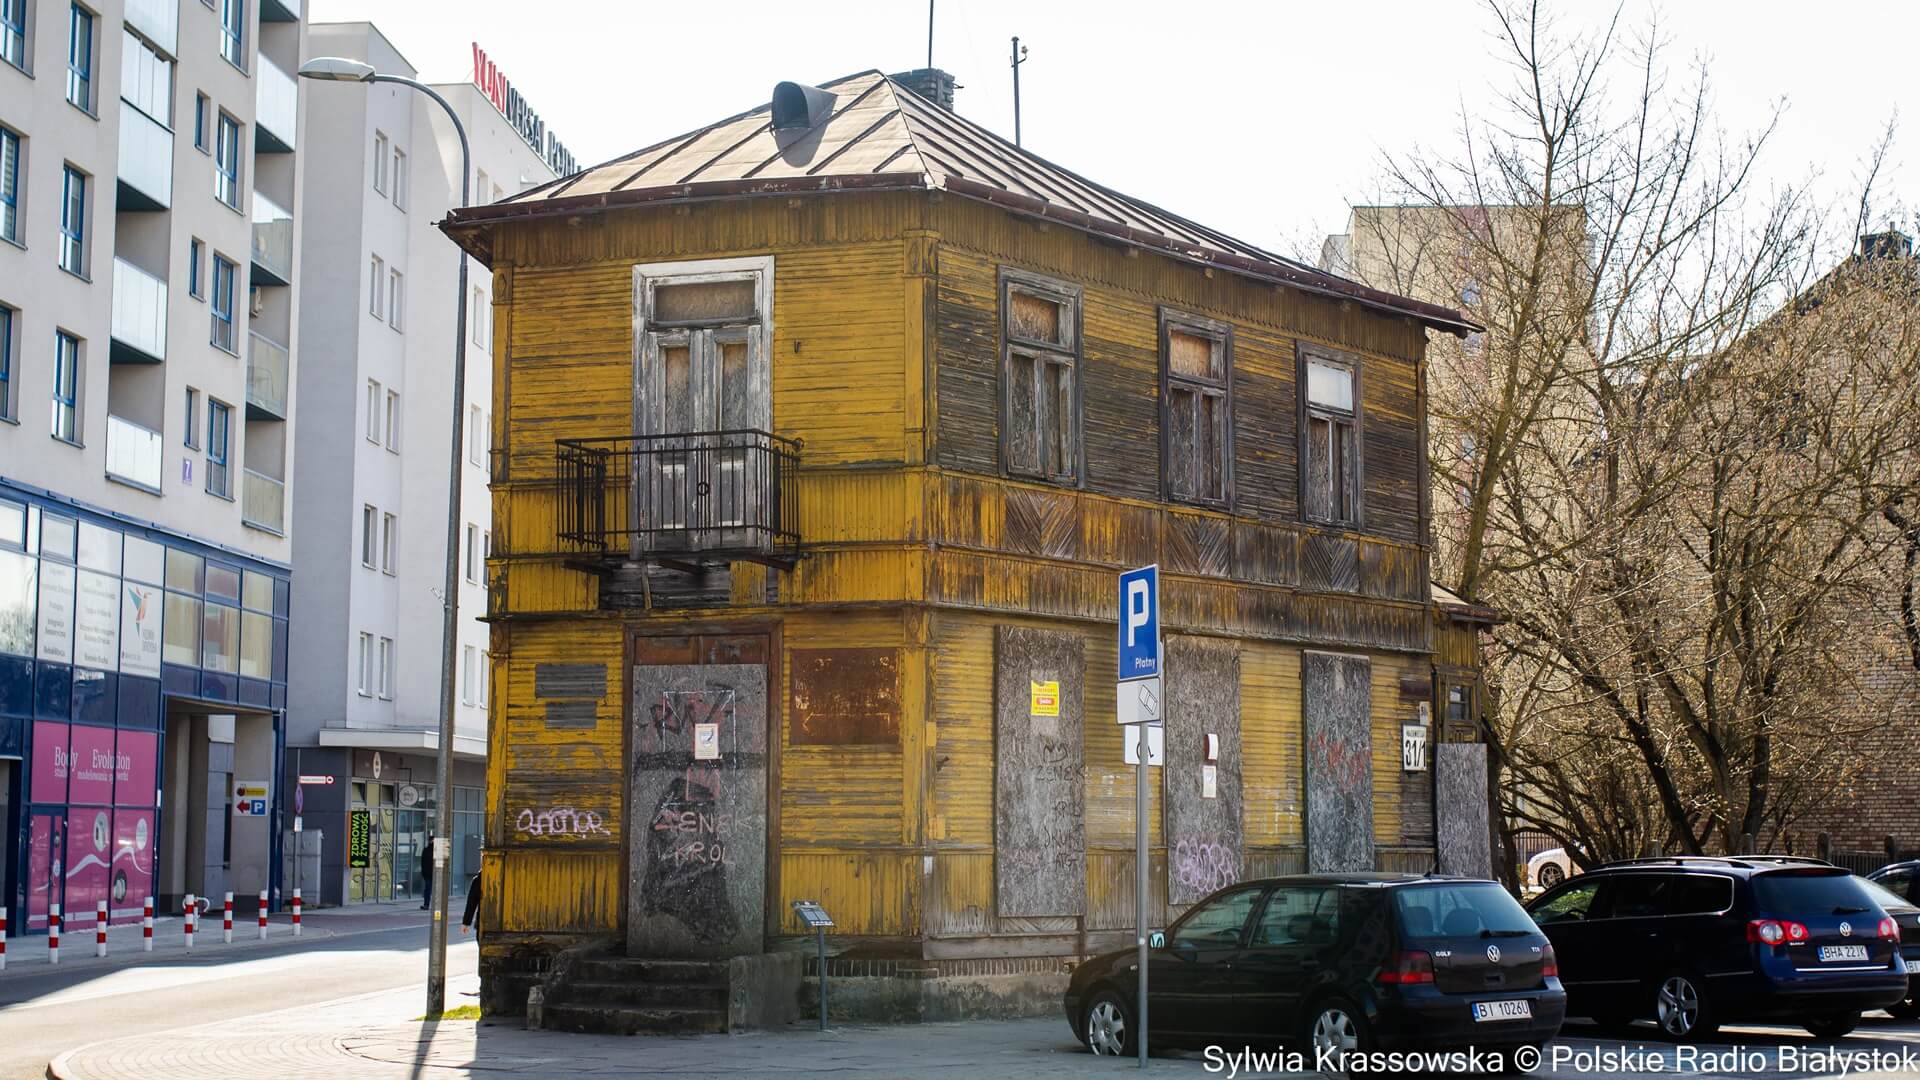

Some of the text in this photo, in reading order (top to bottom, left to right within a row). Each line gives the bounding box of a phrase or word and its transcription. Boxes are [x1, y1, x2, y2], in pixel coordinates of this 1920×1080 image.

[547, 130, 582, 178] POIN
[1127, 578, 1149, 647] P
[92, 748, 131, 770] Evoluion
[1405, 739, 1426, 768] 31/1
[253, 802, 263, 813] P
[351, 813, 360, 857] ZDROWA
[1823, 946, 1844, 958] BHA
[1478, 1003, 1494, 1018] BI
